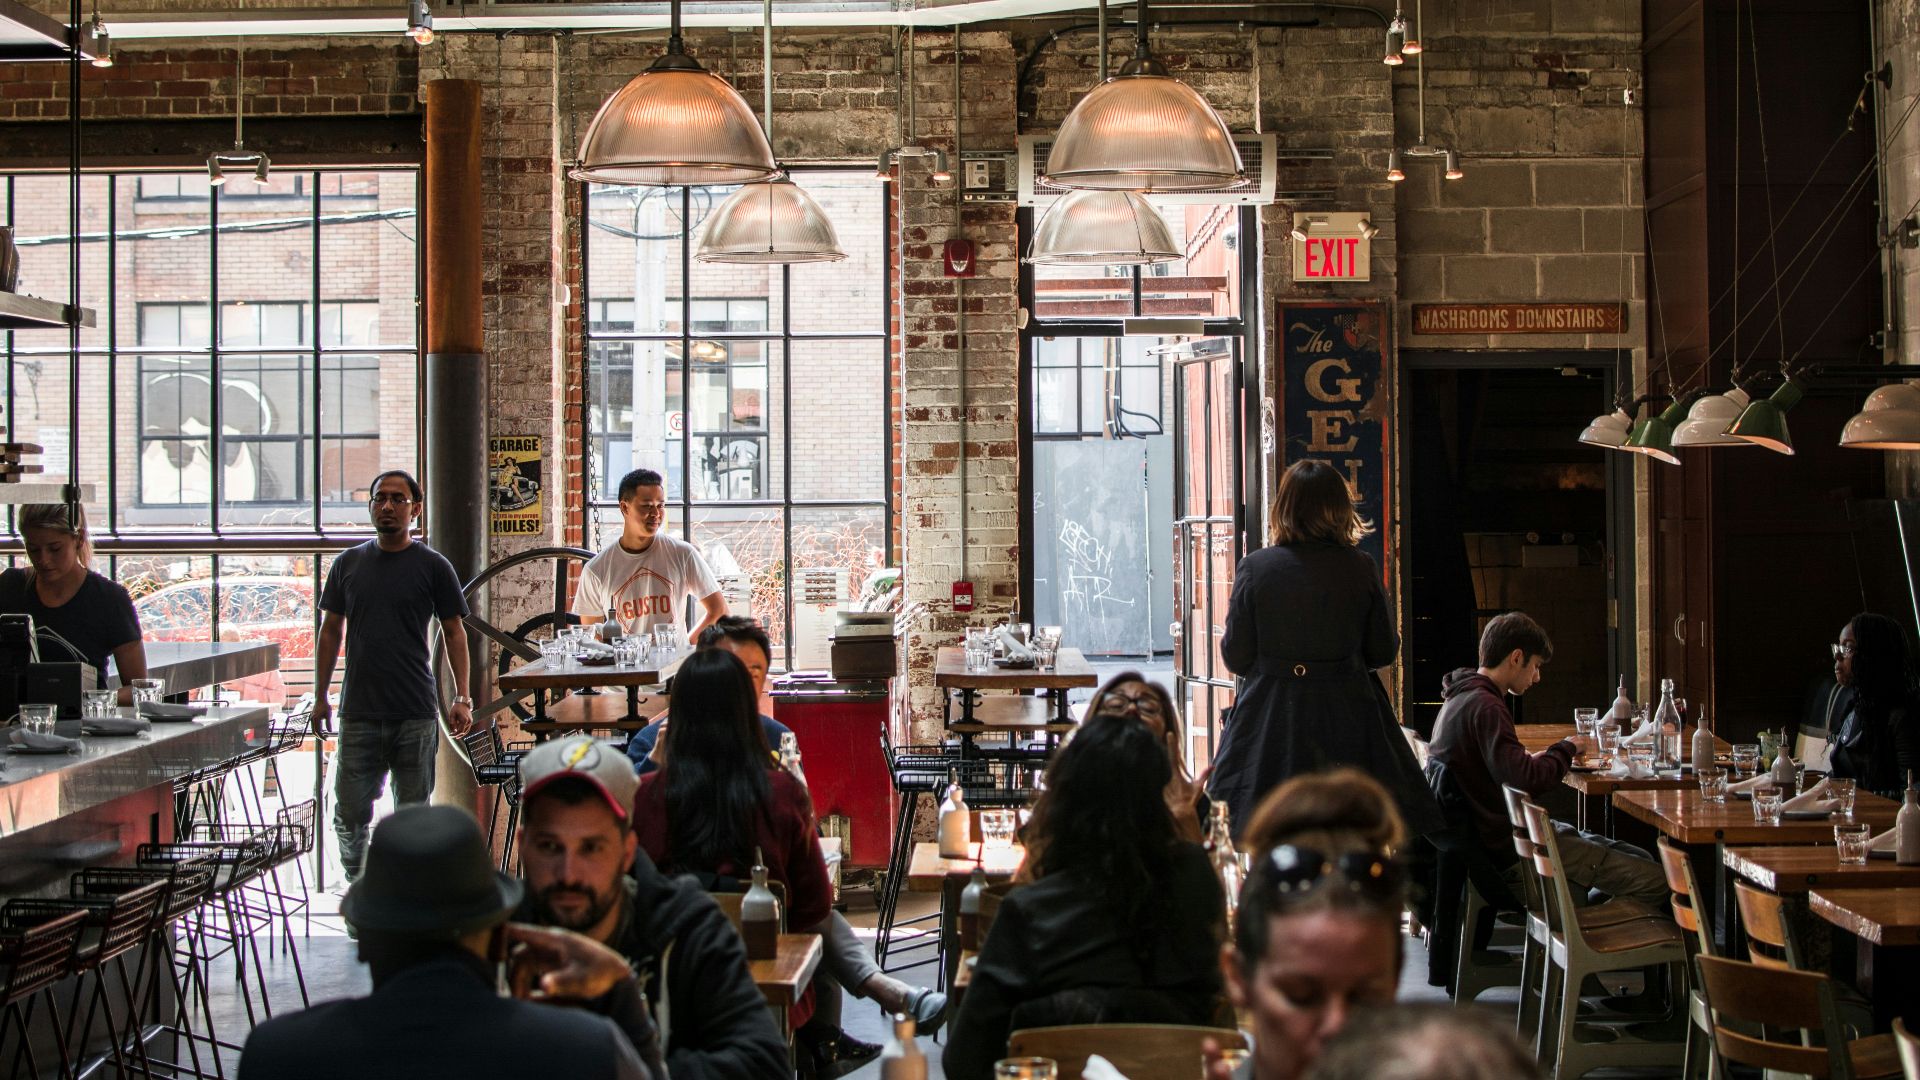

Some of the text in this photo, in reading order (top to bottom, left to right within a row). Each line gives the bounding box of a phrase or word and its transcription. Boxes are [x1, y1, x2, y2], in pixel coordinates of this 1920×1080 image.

[1305, 238, 1359, 277] EXIT
[1419, 307, 1606, 330] WASHROOMS DOWNSTAIRS
[1290, 321, 1334, 353] The
[490, 438, 539, 452] GARAGE
[493, 519, 540, 533] RULES!
[622, 594, 671, 620] GUSTO
